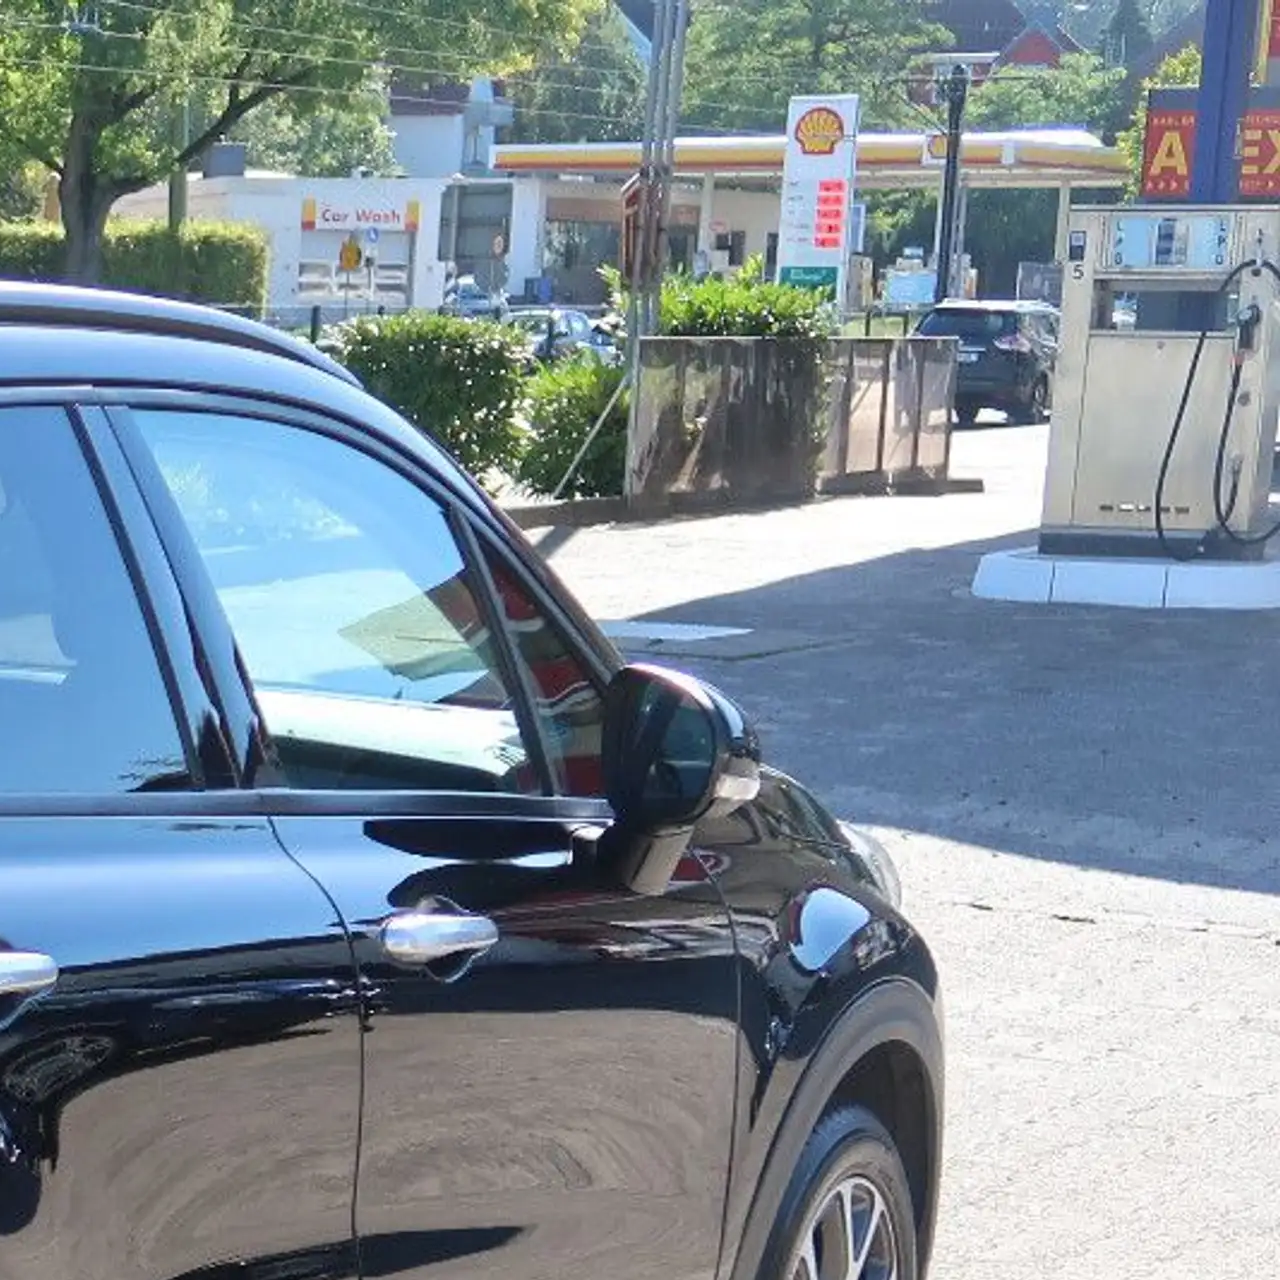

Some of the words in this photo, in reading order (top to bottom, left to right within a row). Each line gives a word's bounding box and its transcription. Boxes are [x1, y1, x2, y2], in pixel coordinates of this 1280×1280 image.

[322, 208, 349, 222] Car
[356, 209, 401, 223] Wash
[1072, 264, 1085, 280] 5
